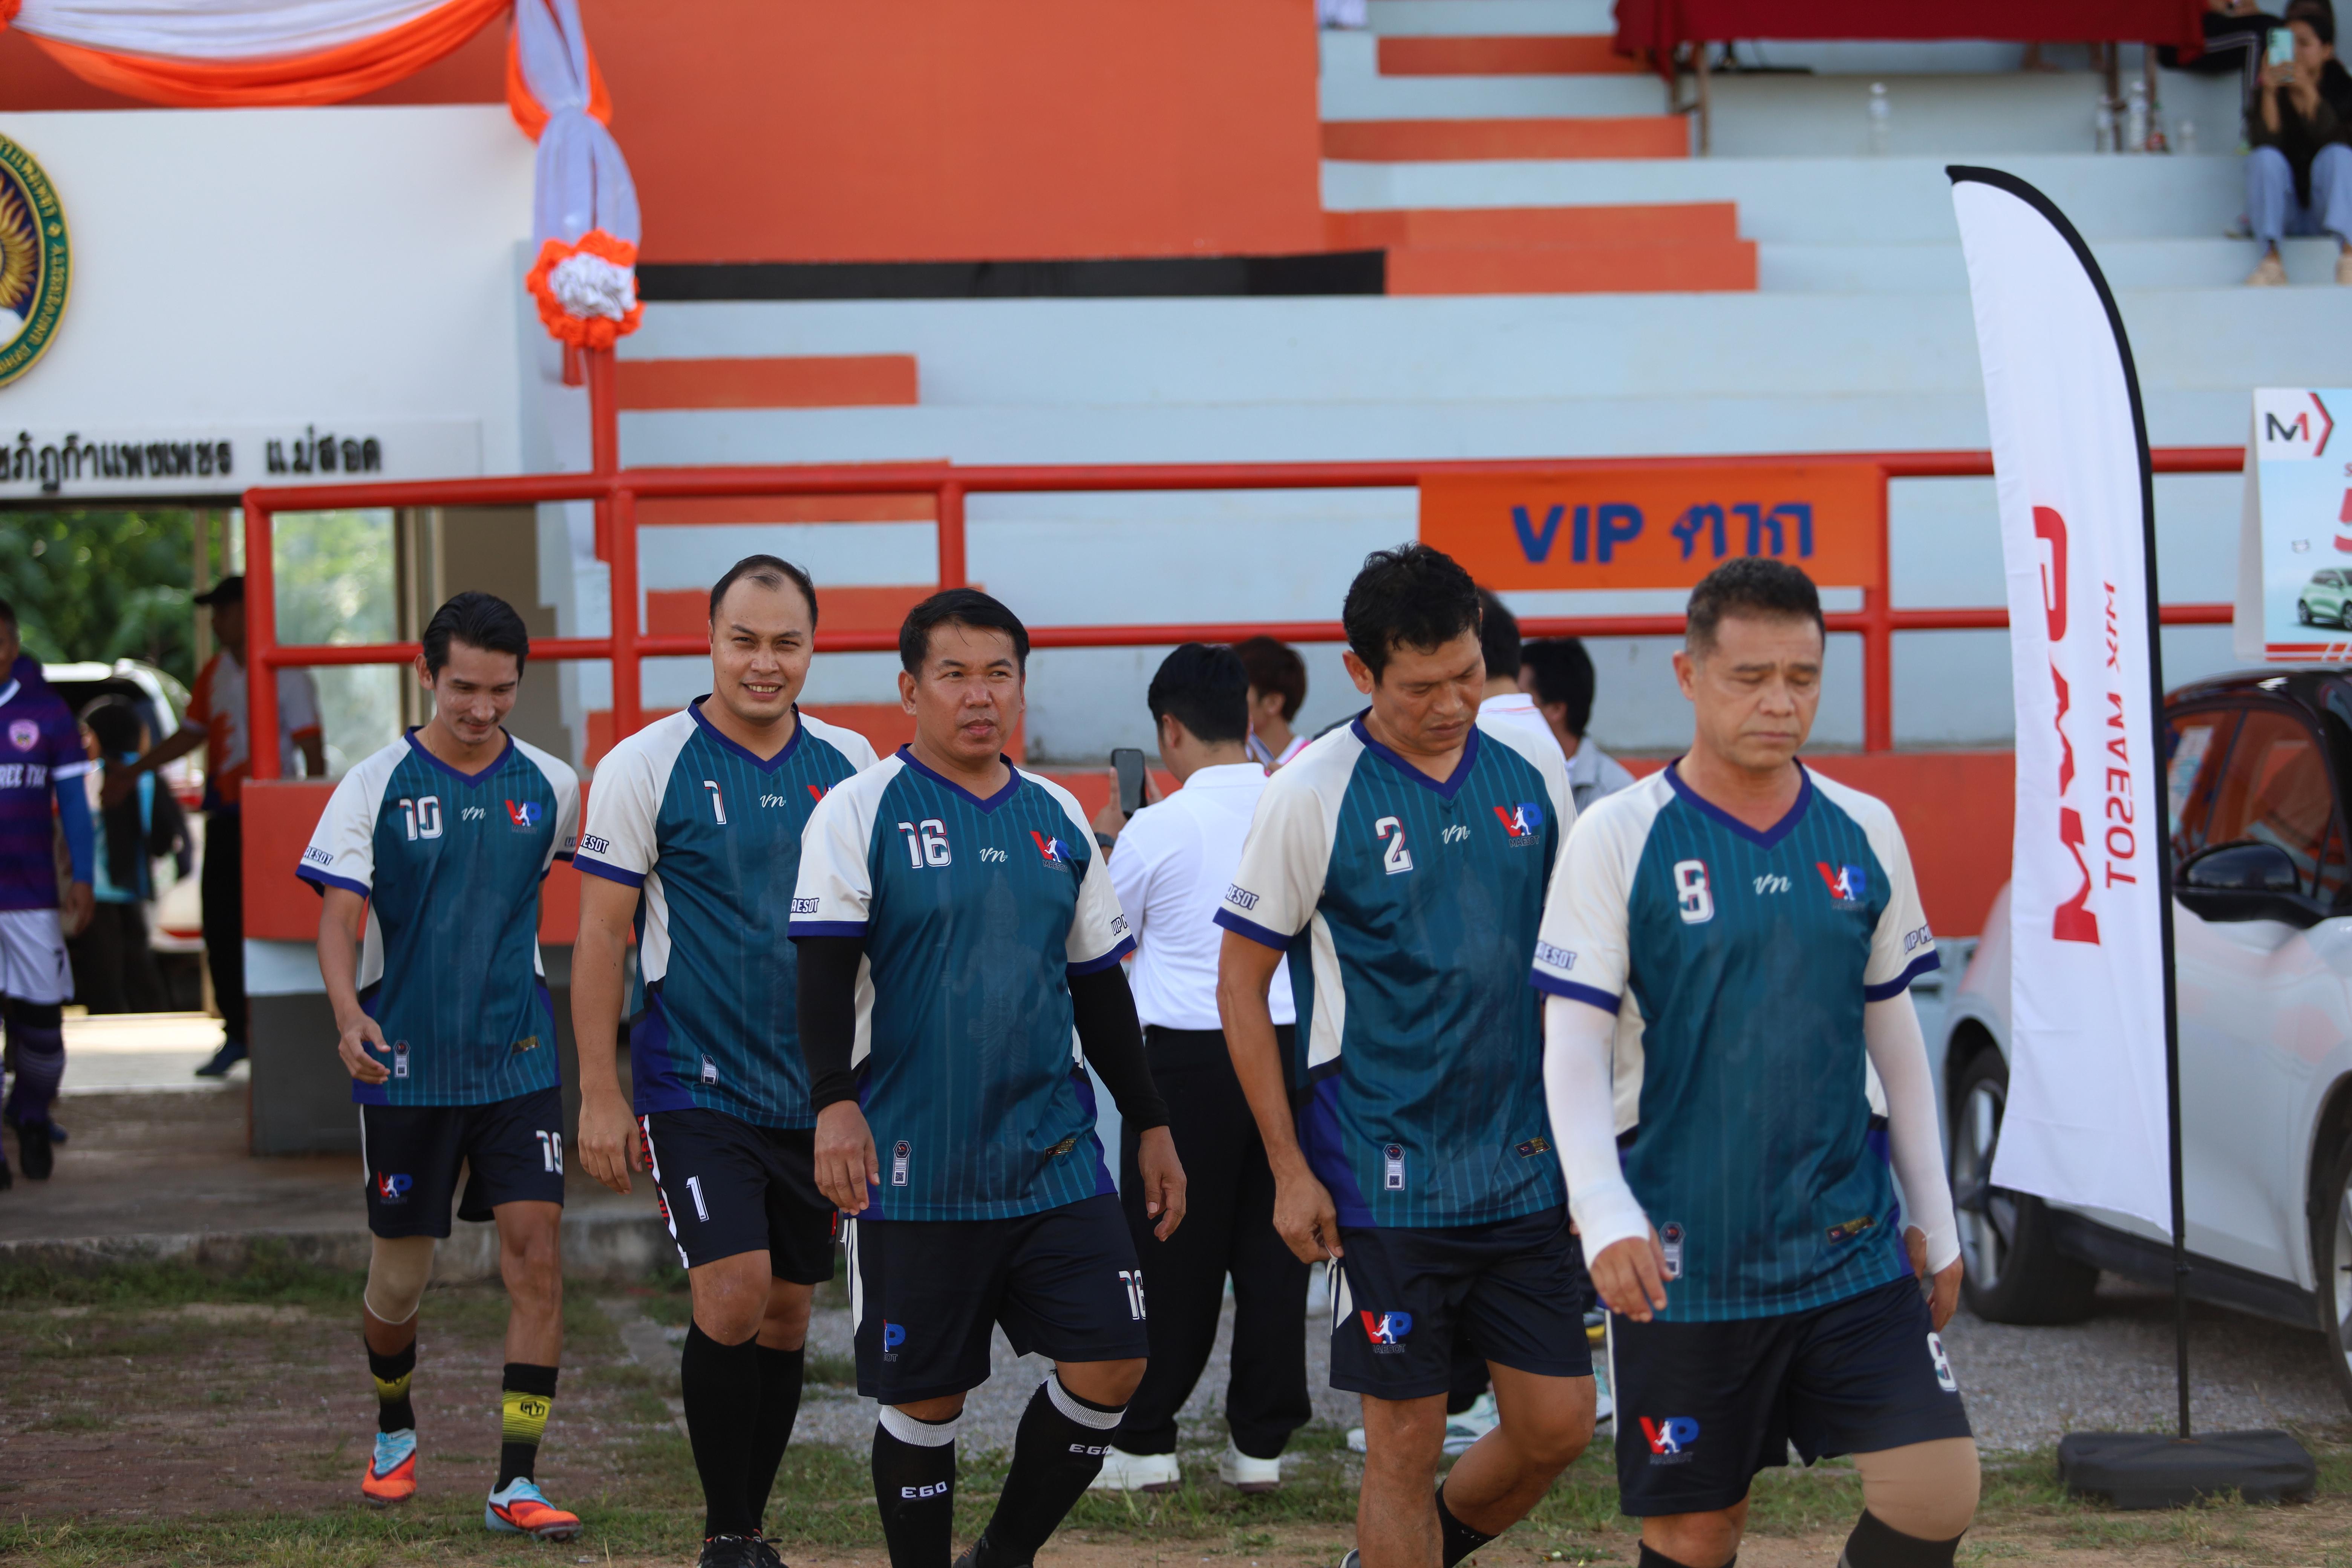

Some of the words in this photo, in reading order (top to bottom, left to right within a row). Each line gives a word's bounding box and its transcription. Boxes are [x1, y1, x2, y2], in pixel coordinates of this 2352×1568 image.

[1512, 502, 1644, 563] VIP
[399, 795, 443, 841] 10
[703, 780, 727, 824] 1
[580, 833, 609, 854] ESOT
[897, 818, 951, 868] 16
[1375, 815, 1413, 874] 2
[1509, 836, 1540, 848] MAESOT
[1043, 859, 1068, 872] MAESOT
[1111, 916, 1122, 936] VIP
[536, 1130, 563, 1176] 10
[686, 1175, 709, 1222] 1
[902, 1481, 947, 1498] EGO
